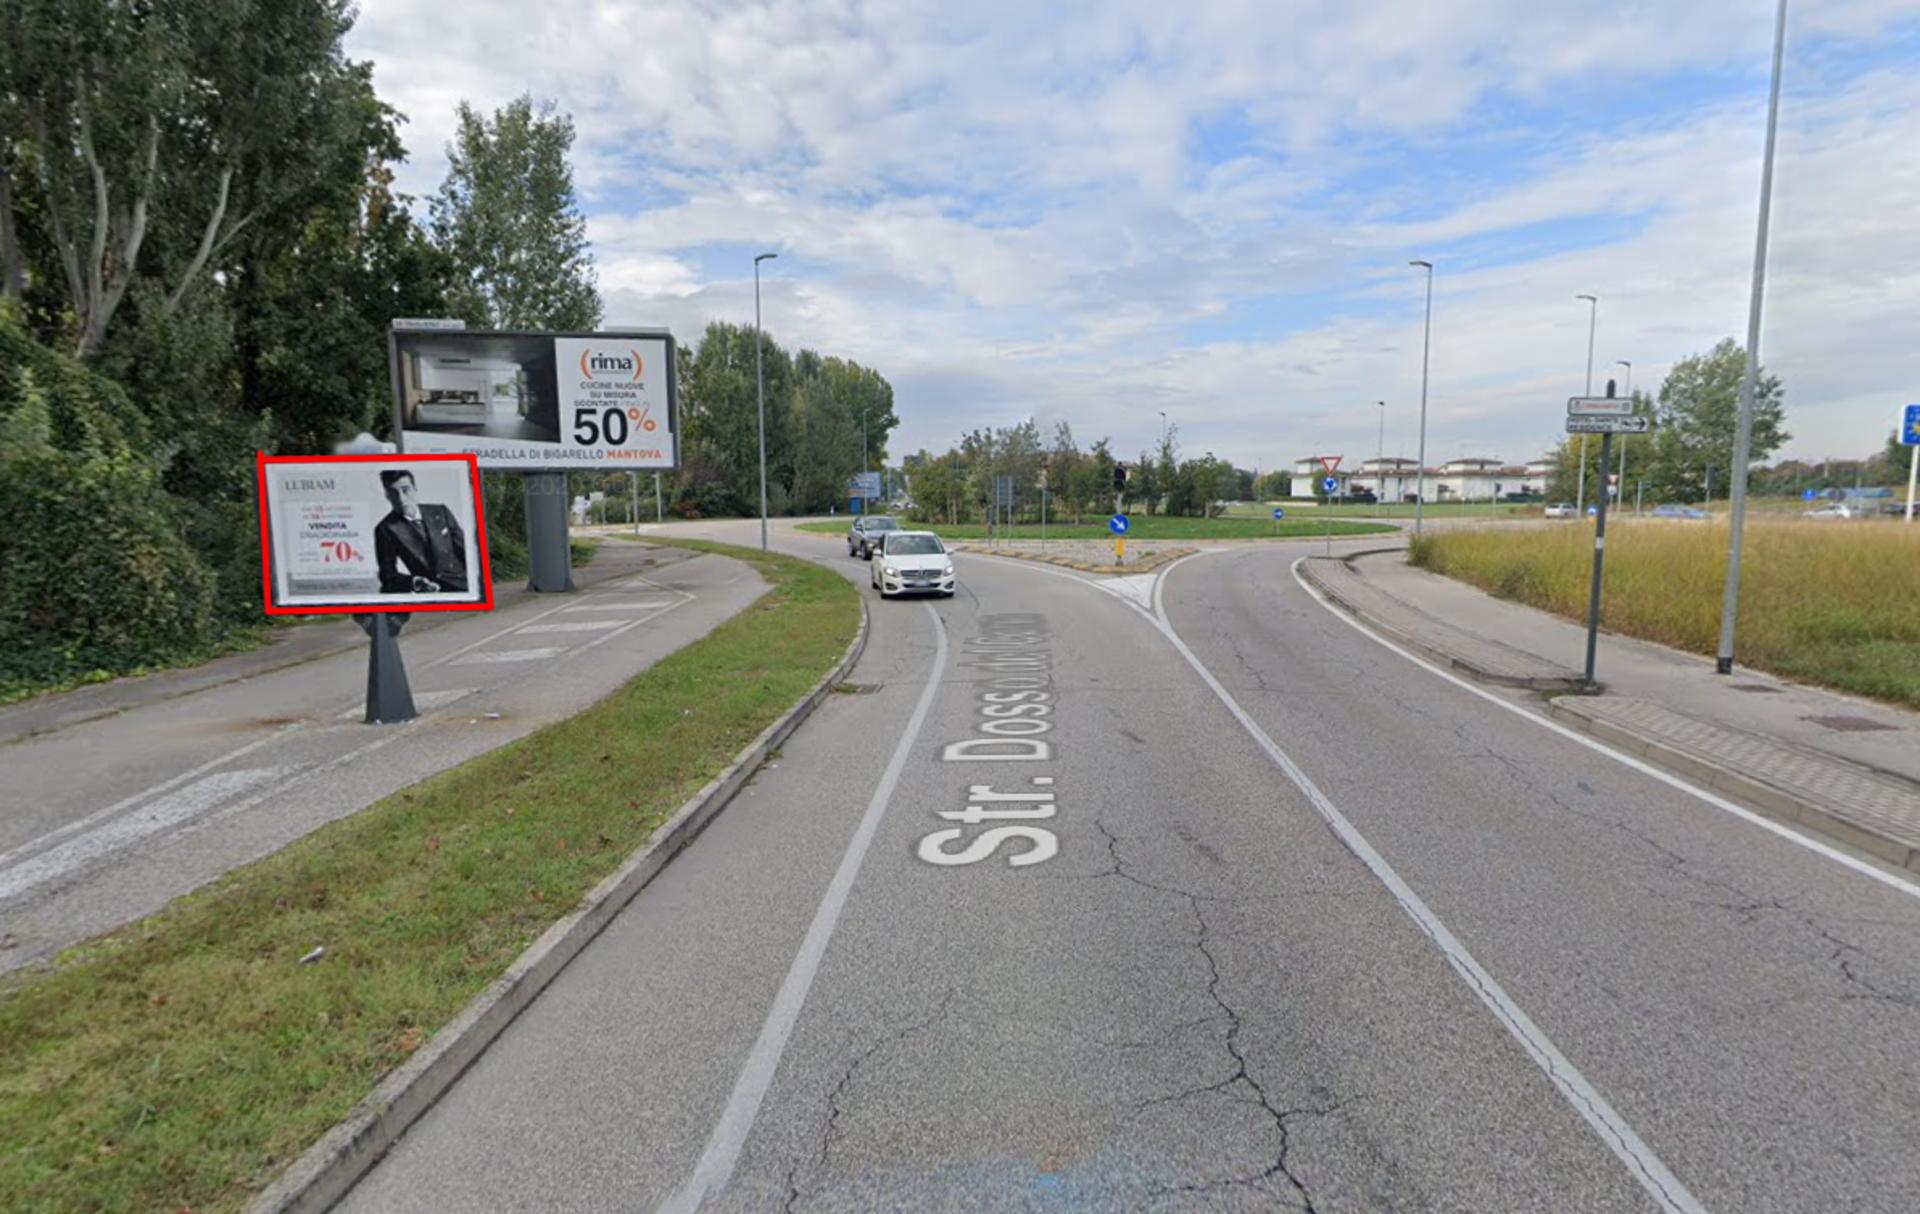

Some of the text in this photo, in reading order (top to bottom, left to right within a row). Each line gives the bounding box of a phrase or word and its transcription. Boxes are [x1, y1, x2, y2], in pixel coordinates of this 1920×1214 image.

[580, 382, 644, 390] CUCINE NUOVE
[590, 391, 637, 399] SU MISURA
[573, 407, 657, 446] 50%
[529, 448, 541, 459] DI
[543, 448, 604, 460] BIGARELLO
[606, 448, 662, 459] MANTOVA
[285, 480, 335, 491] LUBIAM
[308, 522, 347, 530] VENDITA
